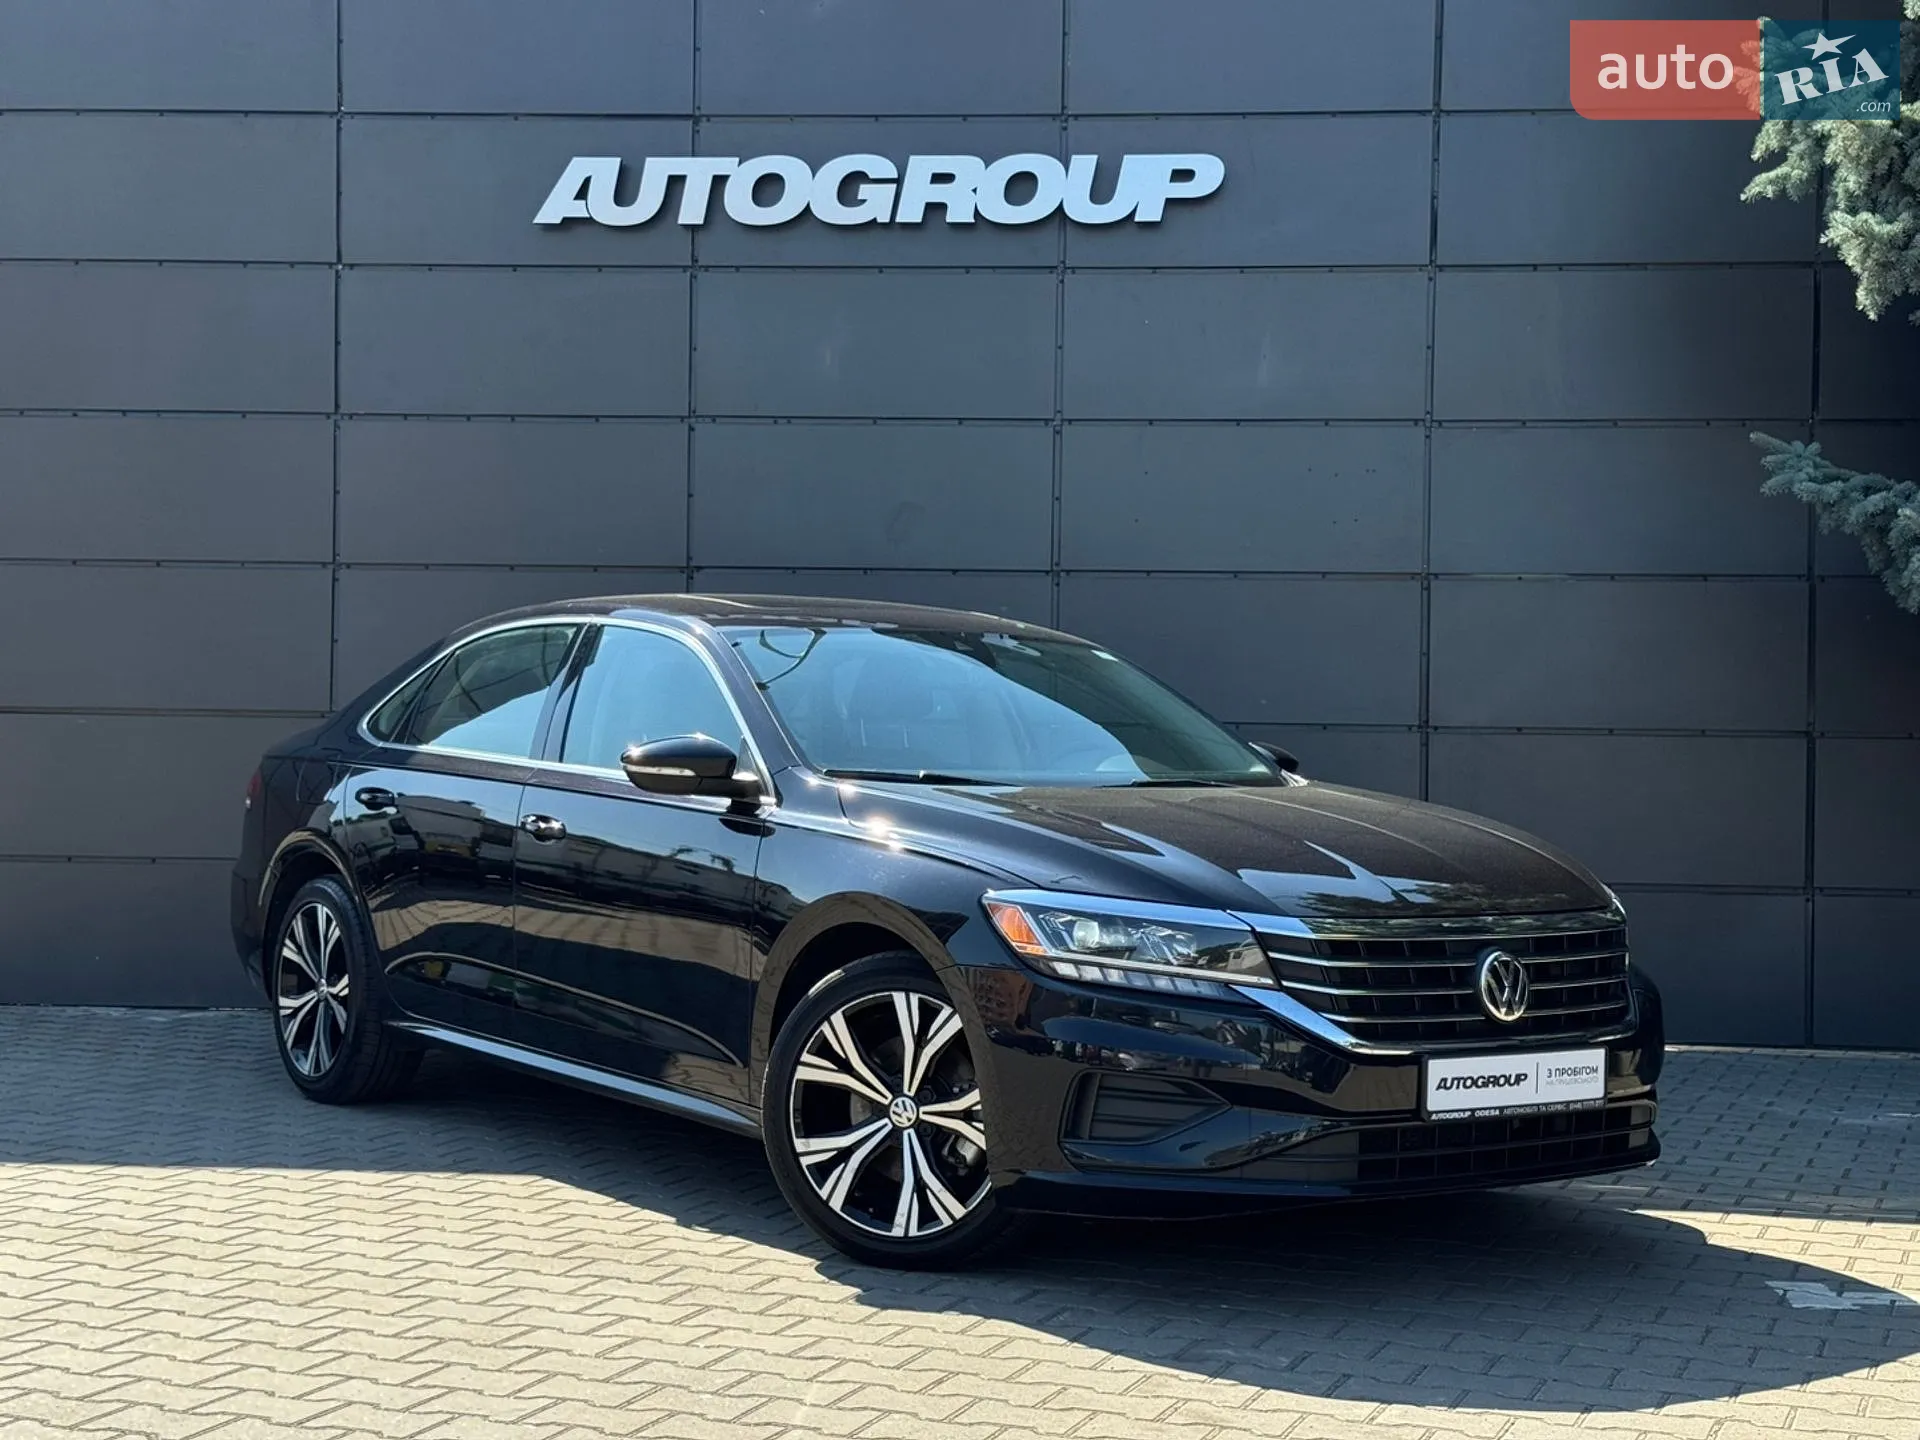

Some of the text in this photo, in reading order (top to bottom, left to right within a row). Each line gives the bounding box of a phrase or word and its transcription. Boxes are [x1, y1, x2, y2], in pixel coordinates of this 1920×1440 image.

[533, 153, 1226, 227] AUTOGROUP
[1554, 1065, 1599, 1078] ПРОБІГОМ
[1435, 1072, 1528, 1092] AUTOGROUP
